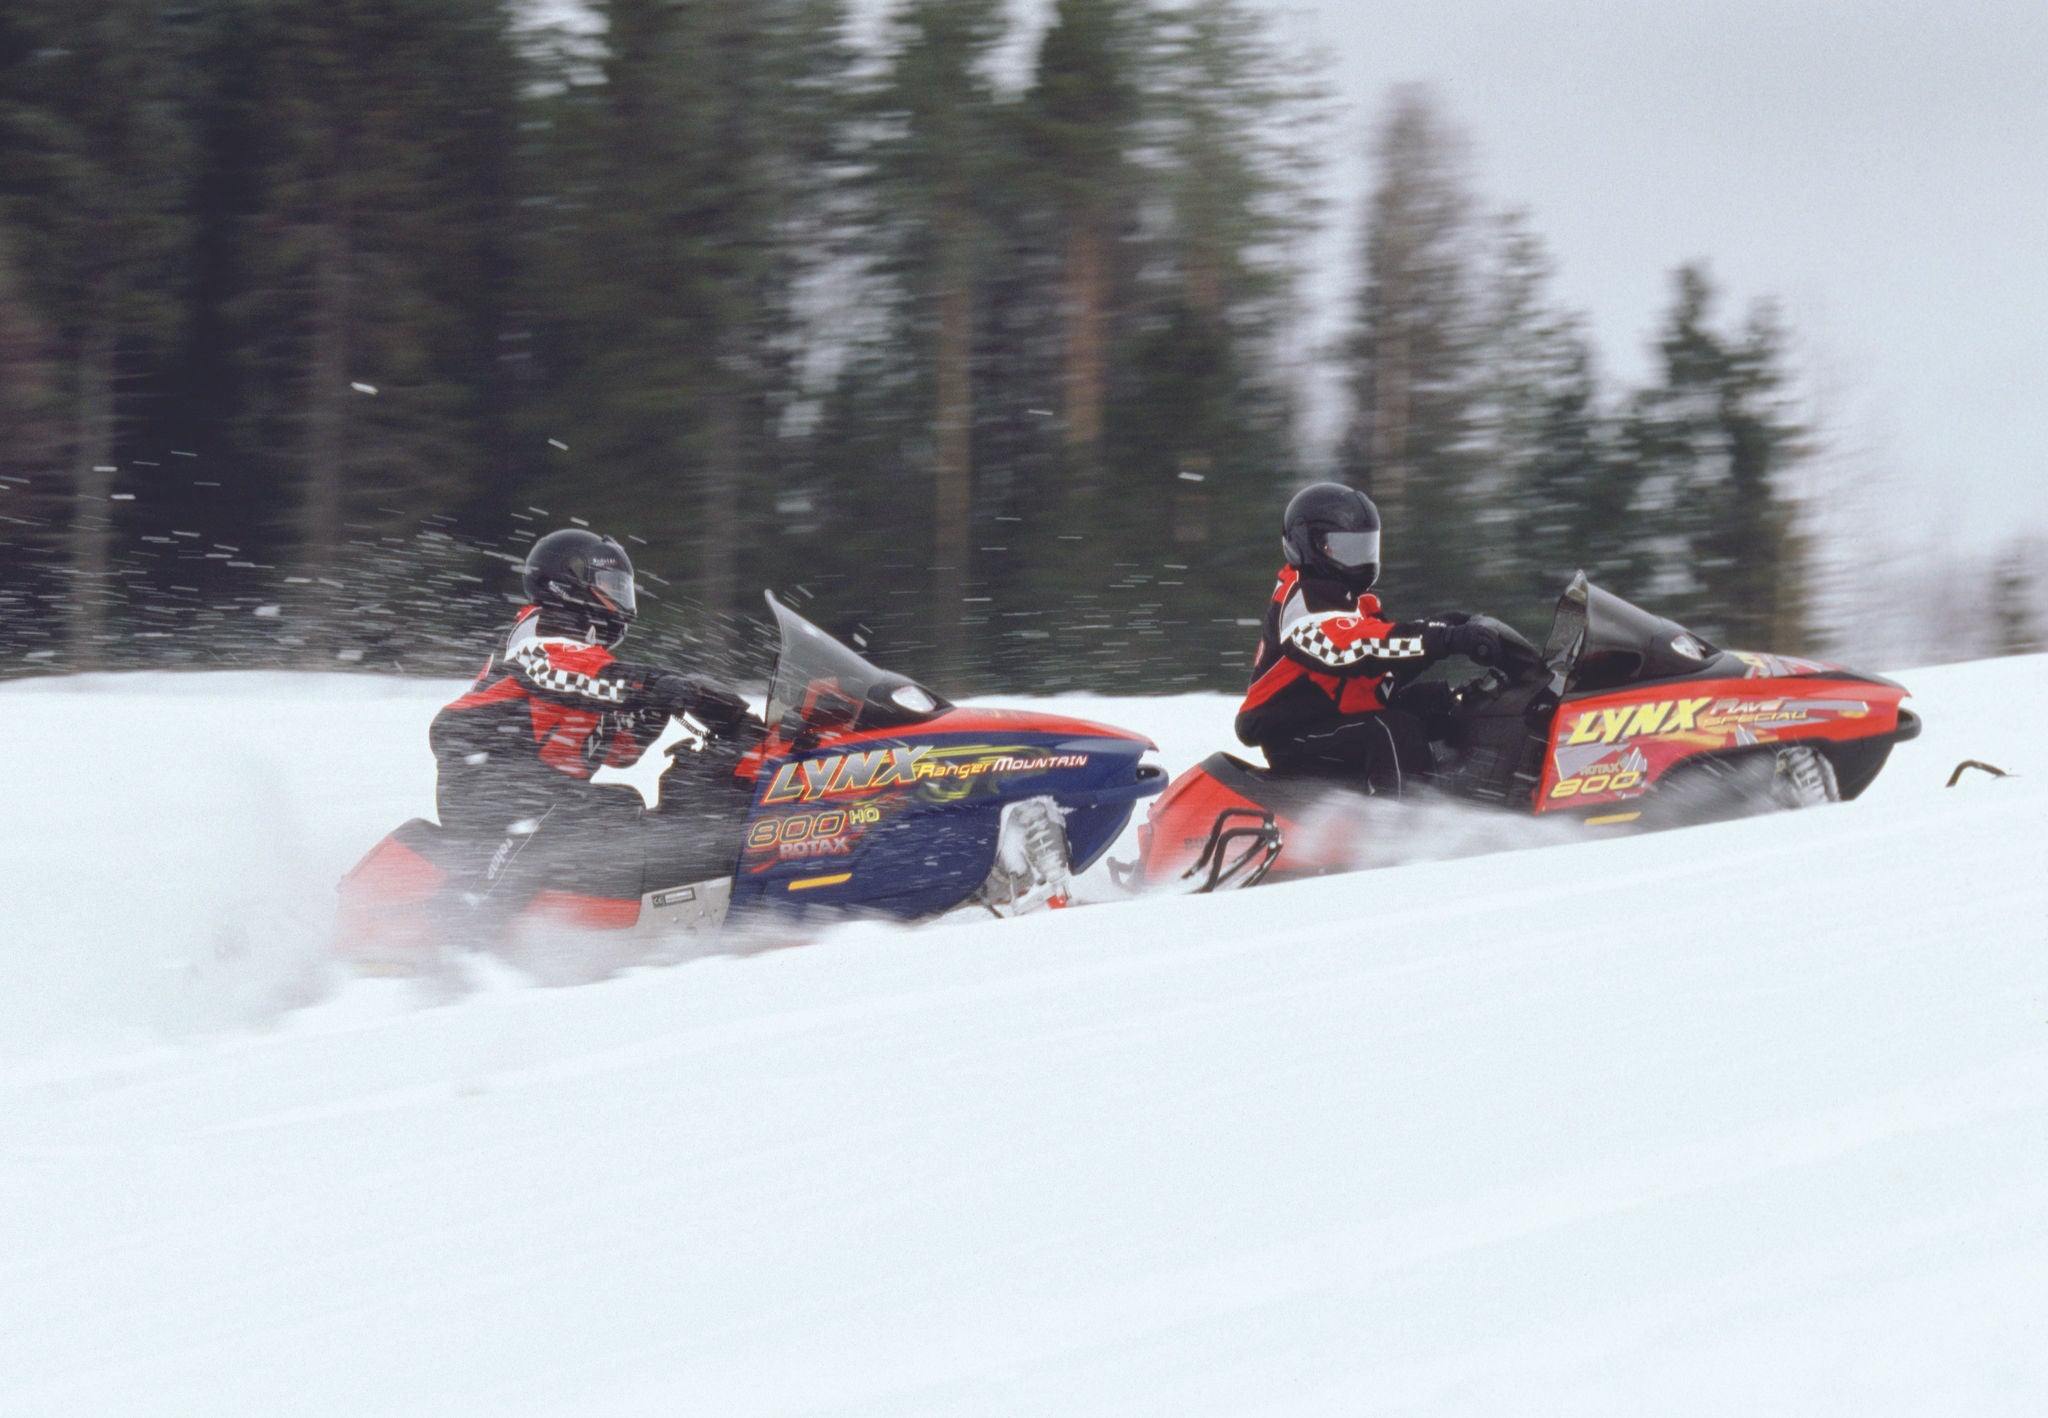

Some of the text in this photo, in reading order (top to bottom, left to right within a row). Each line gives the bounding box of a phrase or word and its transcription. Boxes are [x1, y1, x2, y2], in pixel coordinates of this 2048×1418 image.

[1566, 696, 1713, 746] LYNX
[762, 744, 935, 804] LYNX
[917, 761, 992, 780] Ranger
[1549, 771, 1640, 799] 800
[747, 807, 880, 849] 800 HO
[780, 838, 849, 858] ROTAX
